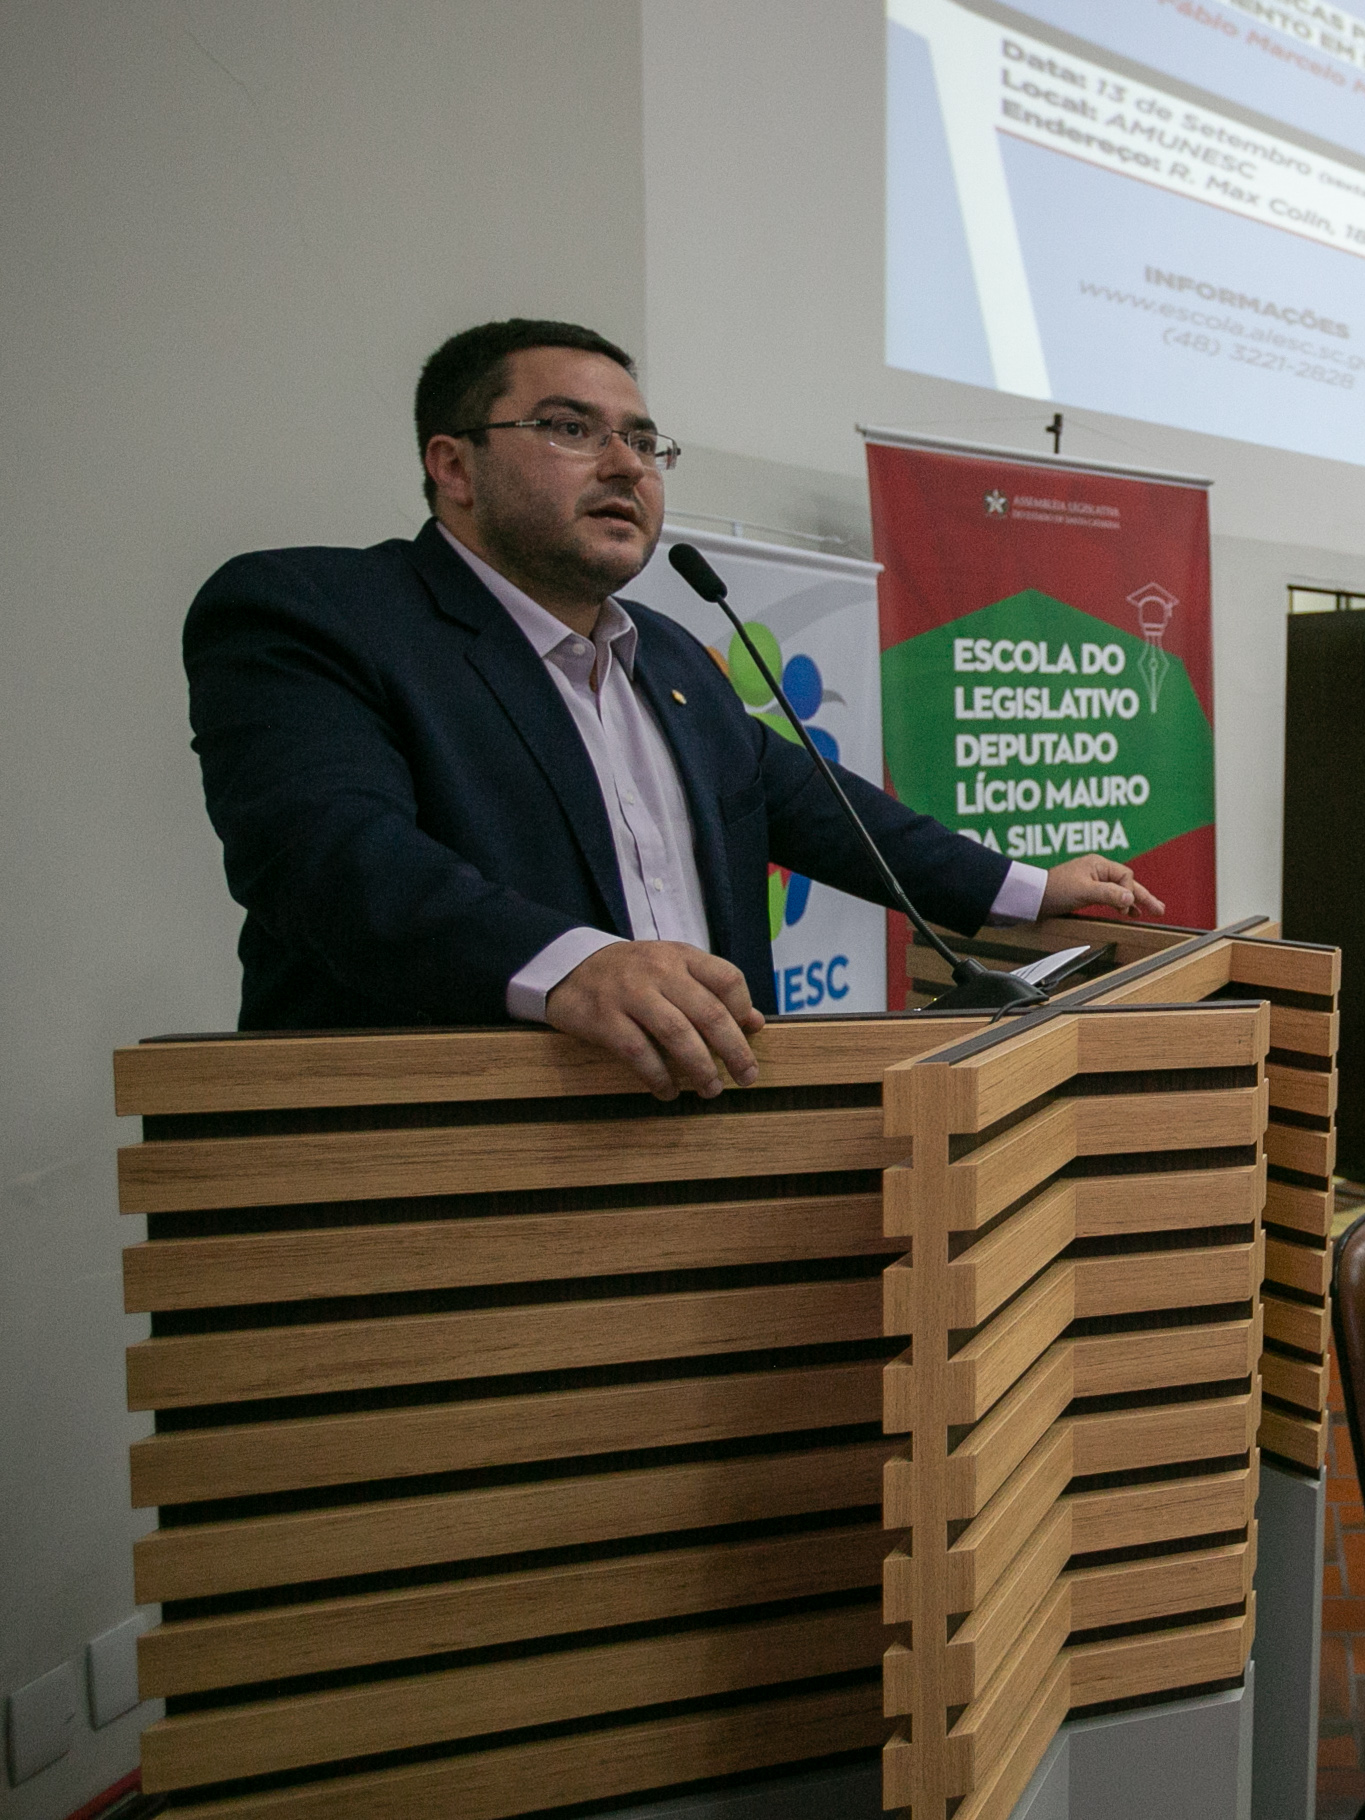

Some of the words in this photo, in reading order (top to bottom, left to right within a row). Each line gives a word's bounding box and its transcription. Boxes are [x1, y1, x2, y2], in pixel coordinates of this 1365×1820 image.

[1320, 31, 1356, 60] EM
[1001, 38, 1088, 89] Data:
[1097, 78, 1128, 104] 13
[1134, 97, 1173, 122] de
[1181, 112, 1312, 176] Setembro
[1001, 68, 1098, 121] Local:
[1104, 113, 1259, 181] AMUNESC
[1001, 97, 1160, 174] Endereço:
[1168, 161, 1197, 186] R.
[1205, 174, 1262, 207] Max
[1268, 197, 1337, 237] Colin,
[1144, 265, 1350, 340] INFORMAÇÕES
[1162, 327, 1222, 357] (48)
[1230, 342, 1355, 390] 3221-2828
[953, 638, 1077, 674] ESCOLA
[1081, 642, 1126, 676] DO
[954, 686, 1140, 720] LEGISLATIVO
[955, 732, 1119, 767] DEPUTADO
[956, 771, 1041, 815] LÍCIO
[1045, 774, 1150, 810] MAURO
[1006, 819, 1130, 858] SILVEIRA
[774, 954, 850, 1012] ESC
